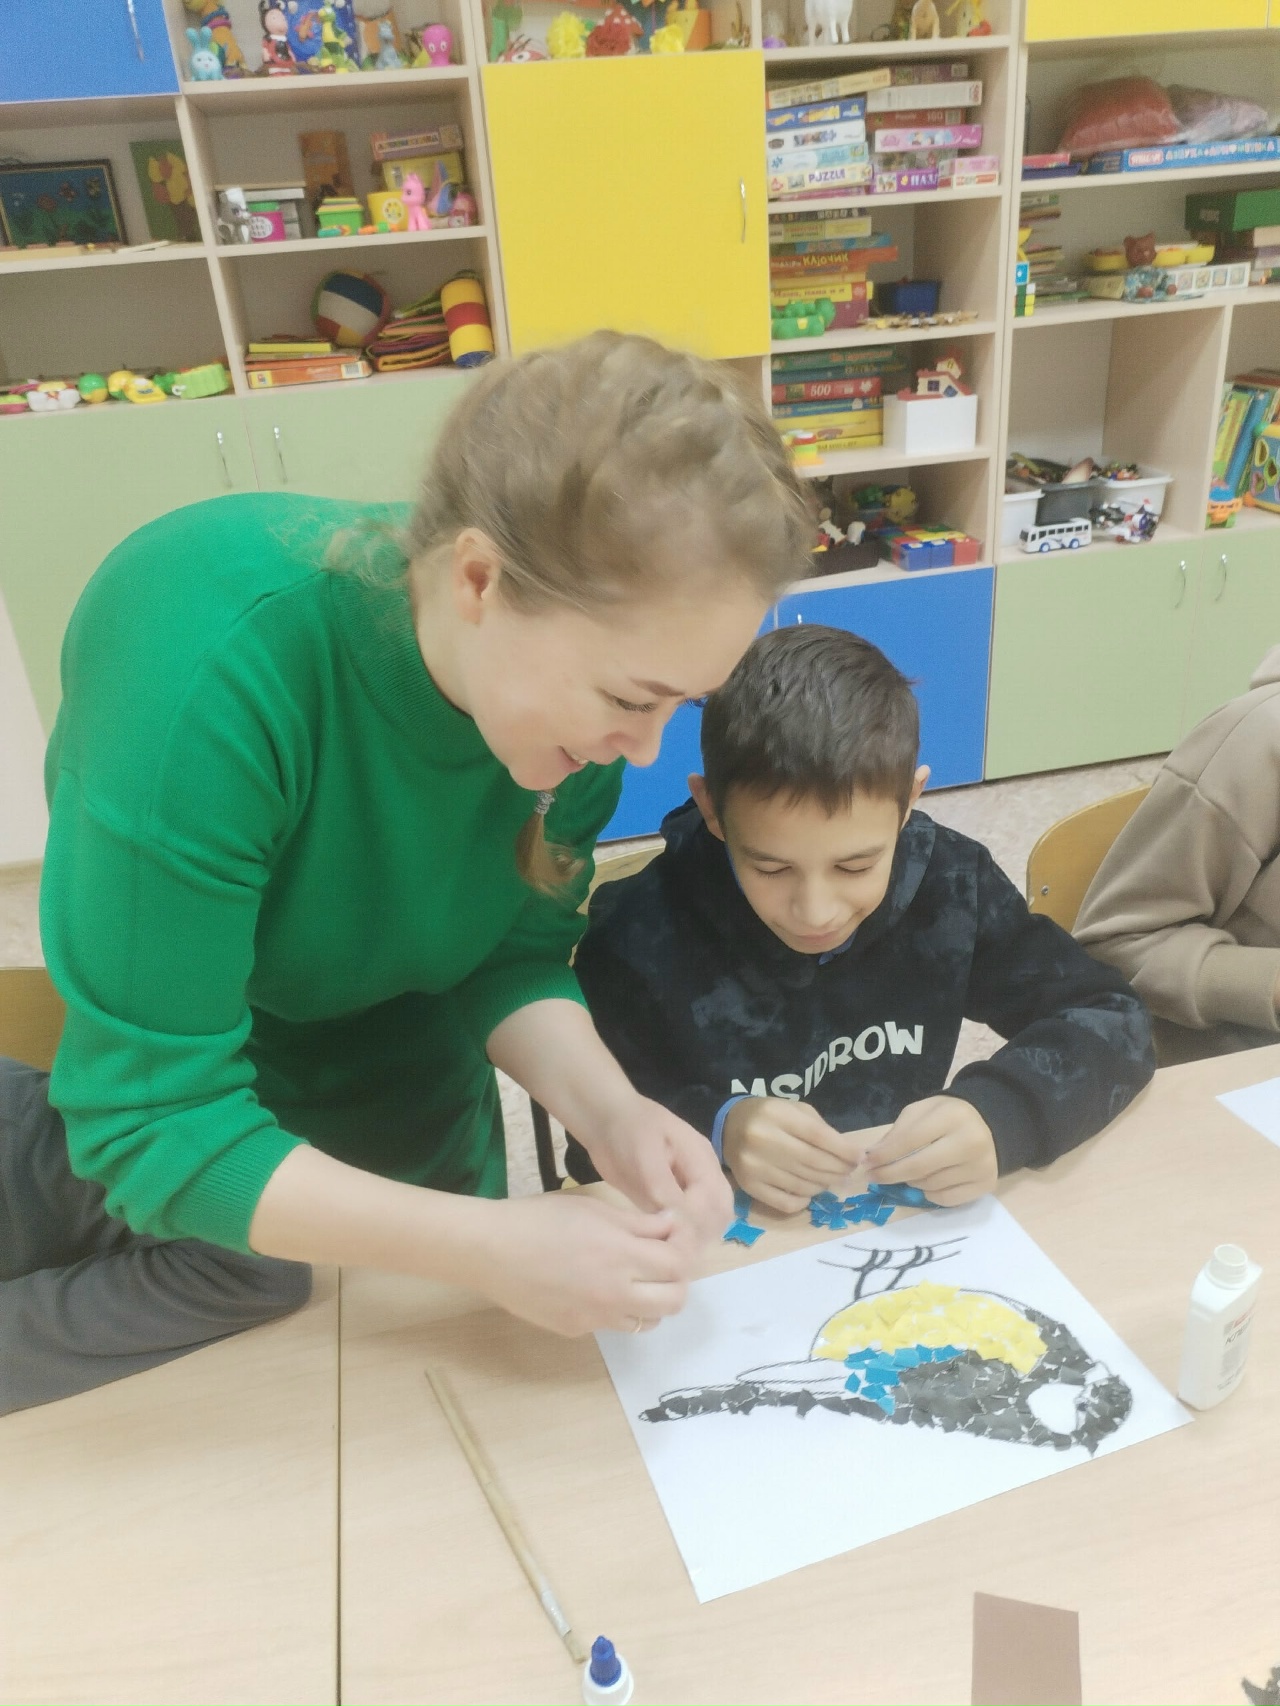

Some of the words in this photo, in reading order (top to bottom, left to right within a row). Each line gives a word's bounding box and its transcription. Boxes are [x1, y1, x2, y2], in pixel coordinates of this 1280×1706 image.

[808, 168, 846, 183] PUZZLE
[802, 253, 848, 267] КЛЮЧИК
[731, 1021, 924, 1101] MSIDROW
